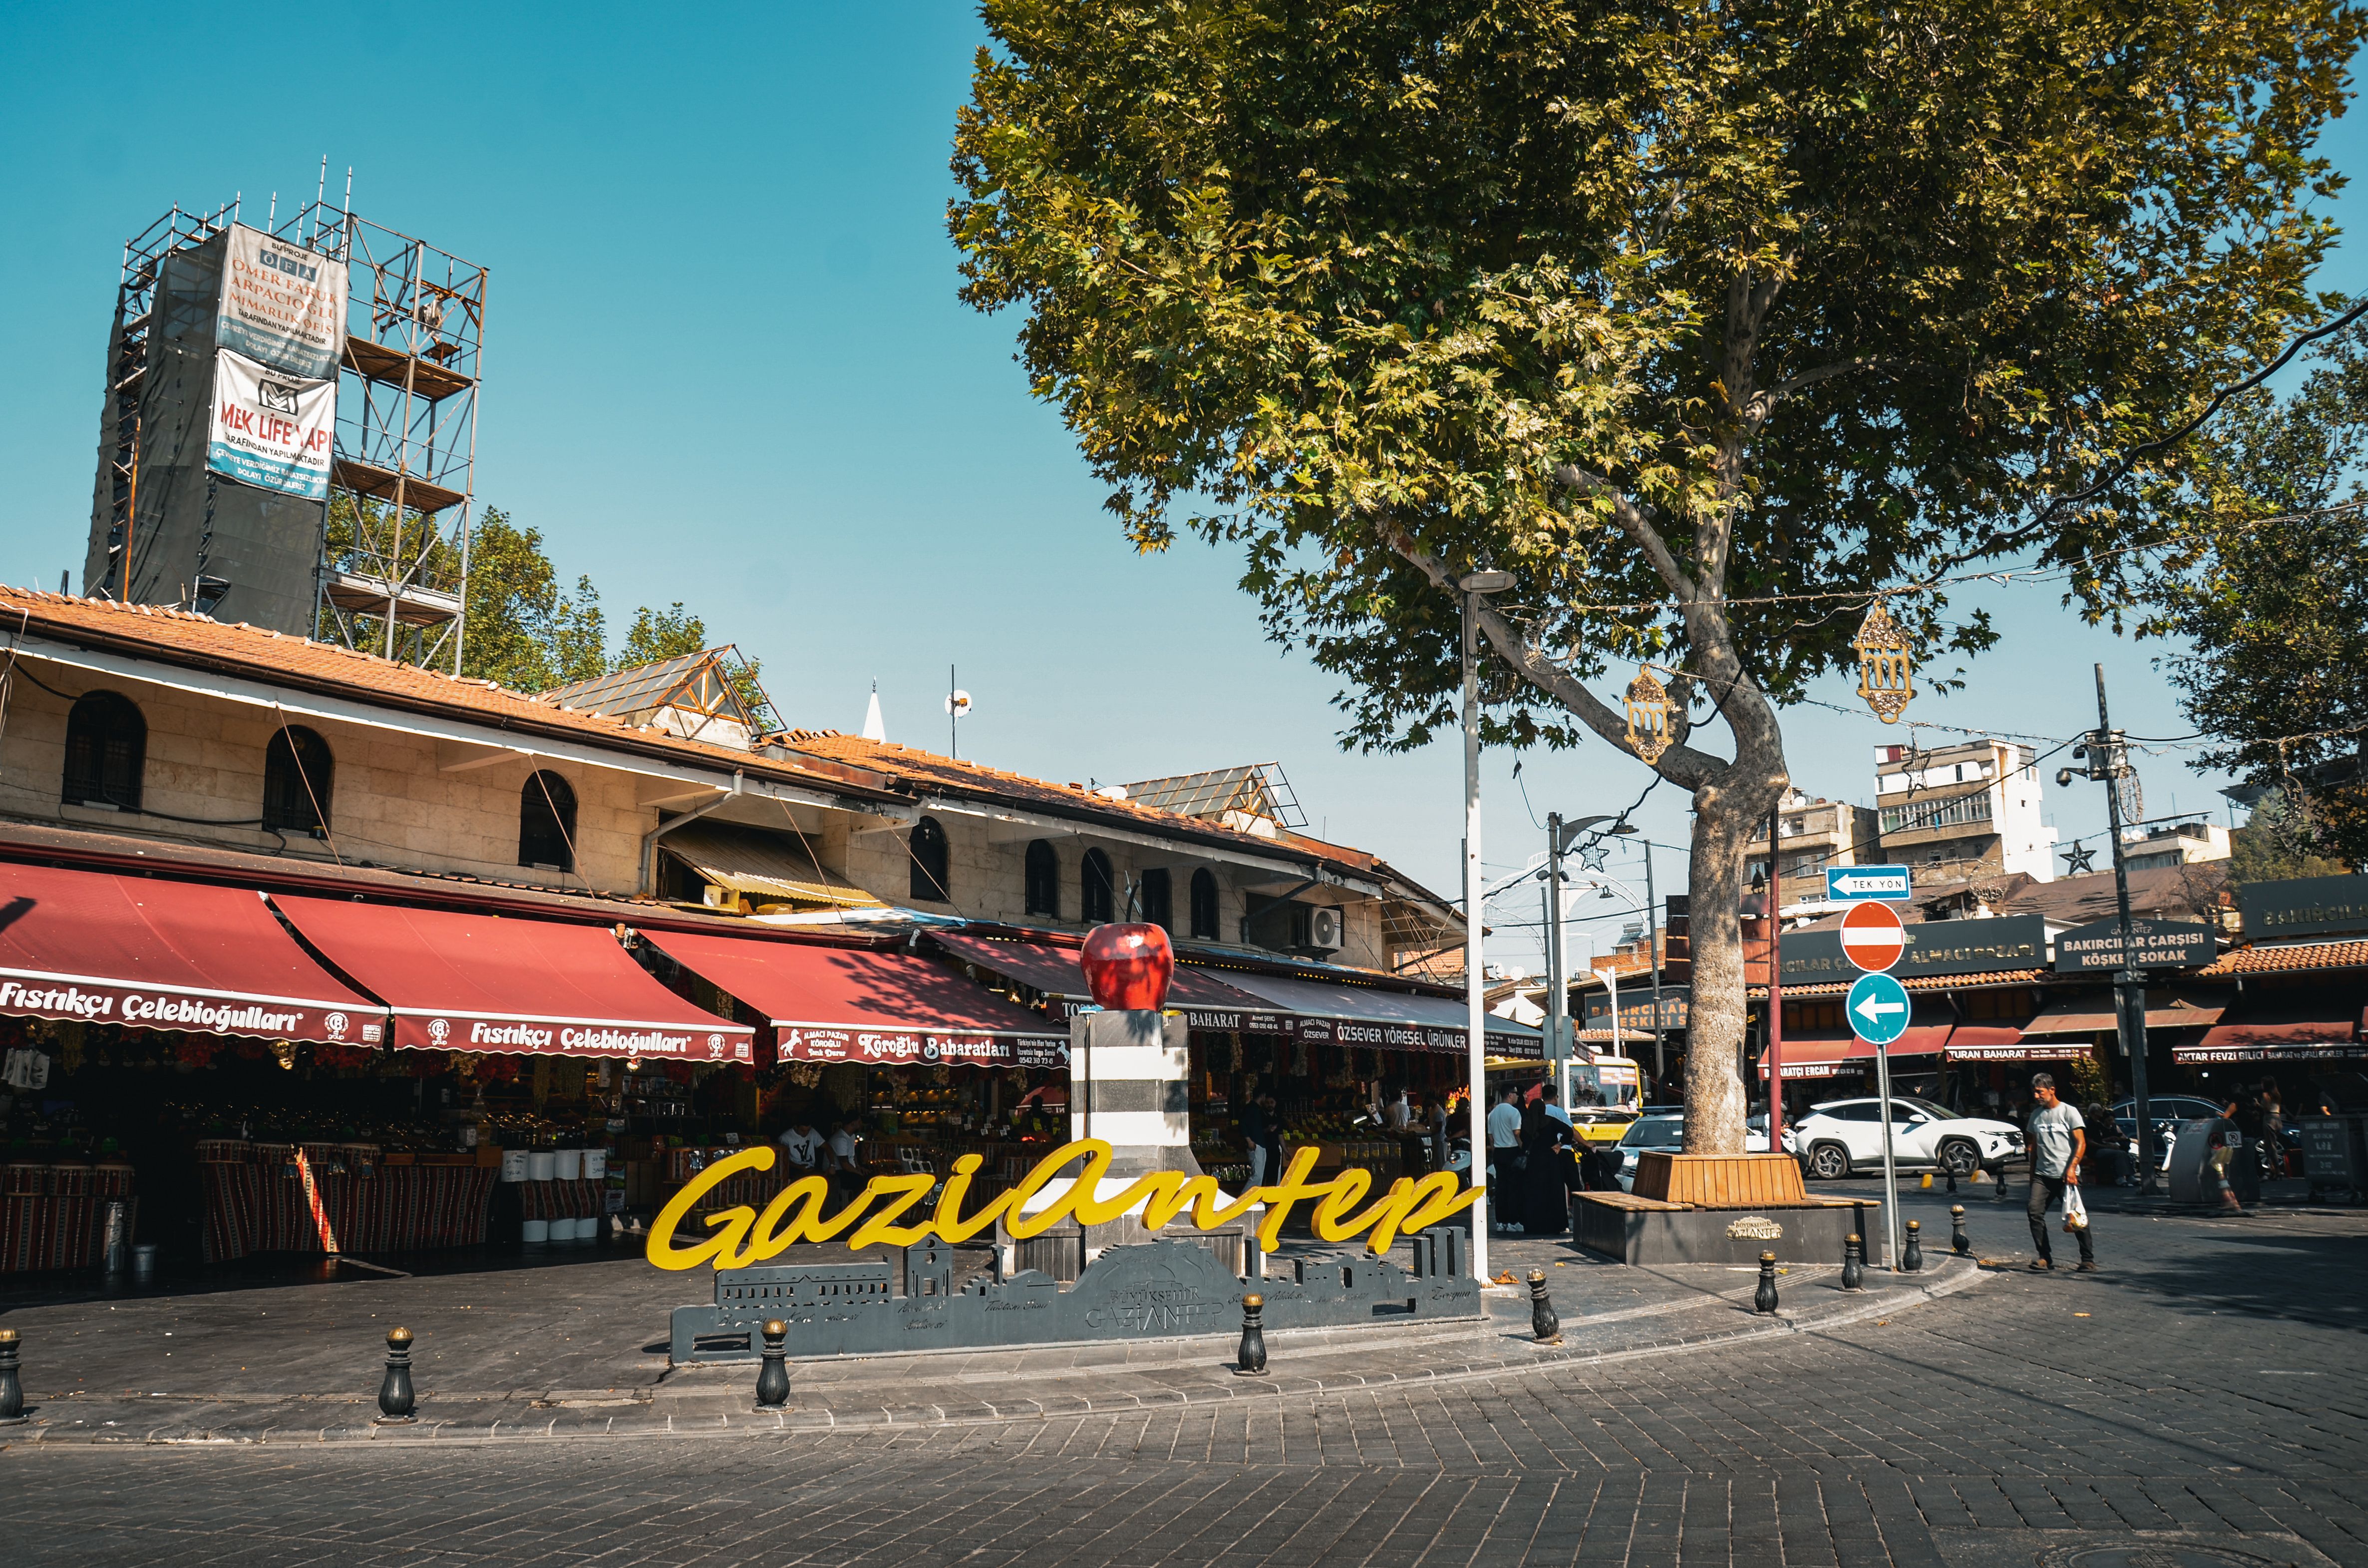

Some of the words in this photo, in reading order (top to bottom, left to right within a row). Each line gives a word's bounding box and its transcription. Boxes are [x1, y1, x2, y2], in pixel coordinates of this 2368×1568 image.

[272, 242, 282, 251] BU
[284, 247, 308, 261] PROJE
[232, 257, 281, 286] ÖMER
[287, 280, 338, 306] FARUK
[230, 292, 300, 324] MİMARLIK
[231, 276, 337, 320] ARPACIOĞLU
[238, 308, 278, 328] TARAFINDAN
[278, 324, 327, 345] YAPILMAKTADIR
[278, 372, 302, 384] PROJE
[220, 400, 255, 435] MEK
[259, 412, 293, 445] LİFE
[296, 424, 332, 454] YAPI
[225, 432, 268, 454] TARAFINDAN
[269, 448, 325, 467] YAPILMAKTADIR
[237, 467, 261, 481] DOLAYI
[264, 473, 283, 486] ÖZÜR
[1879, 878, 1902, 888] YÖN
[2148, 933, 2203, 948] ÇARŞISI
[1909, 947, 1972, 964] ALMACI
[1973, 943, 2035, 959] PAZARI
[2081, 952, 2123, 966] KÖŞKE
[2138, 949, 2187, 963] SOKAK
[0, 982, 113, 1018] Fıstıkçı
[1190, 1012, 1241, 1028] BAHARAT
[470, 1022, 552, 1049] Fıstıkçı
[1304, 1029, 1329, 1039] ÖZSEVER
[1337, 1022, 1381, 1043] ÖZSEVER
[1384, 1026, 1425, 1046] YÖRESEL
[1427, 1029, 1466, 1049] ÜRÜNLER
[857, 1033, 920, 1059] Köroğlu
[924, 1037, 1011, 1060] Baharatları
[1949, 1050, 1981, 1059] TURAN
[1984, 1049, 2027, 1059] BAHARAT
[2178, 1052, 2208, 1061] AKTAR
[1805, 1066, 1830, 1076] ERCAN
